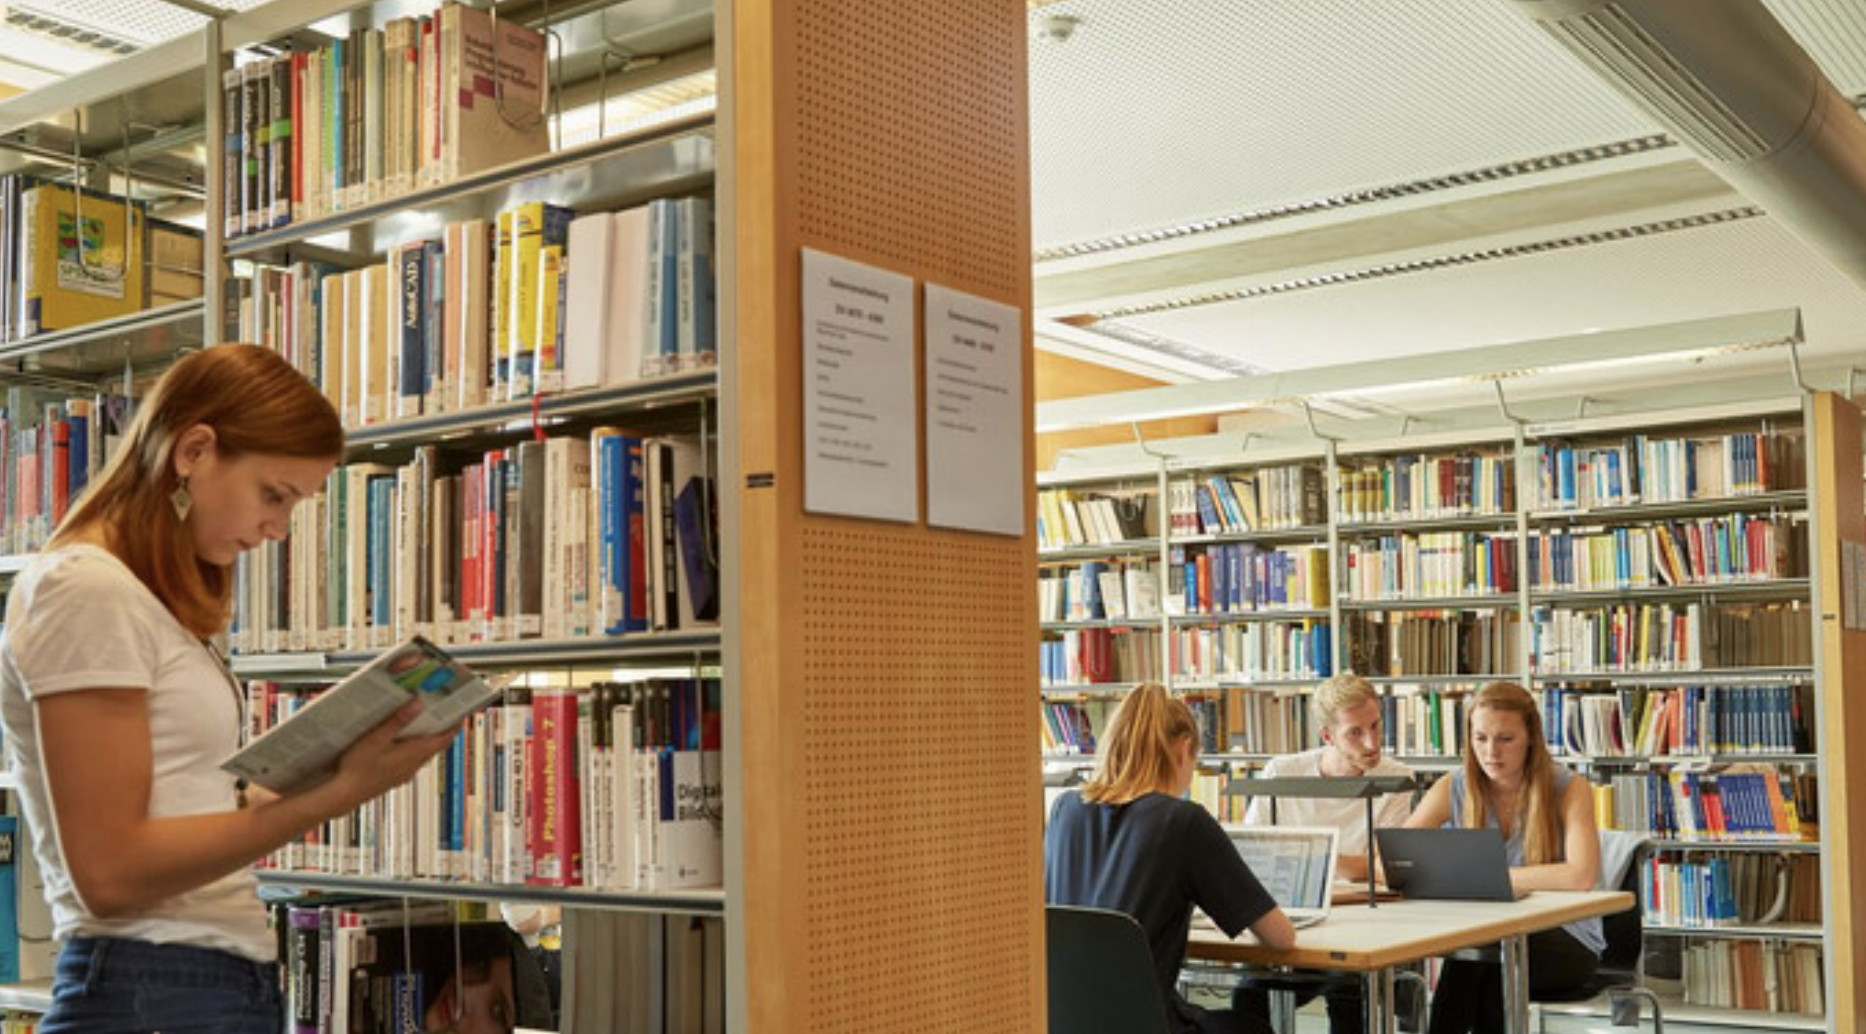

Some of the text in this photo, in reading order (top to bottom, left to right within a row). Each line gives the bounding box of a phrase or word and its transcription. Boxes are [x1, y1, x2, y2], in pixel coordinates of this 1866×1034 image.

[405, 261, 419, 329] AutoCAD
[542, 717, 557, 843] Photoshop 7
